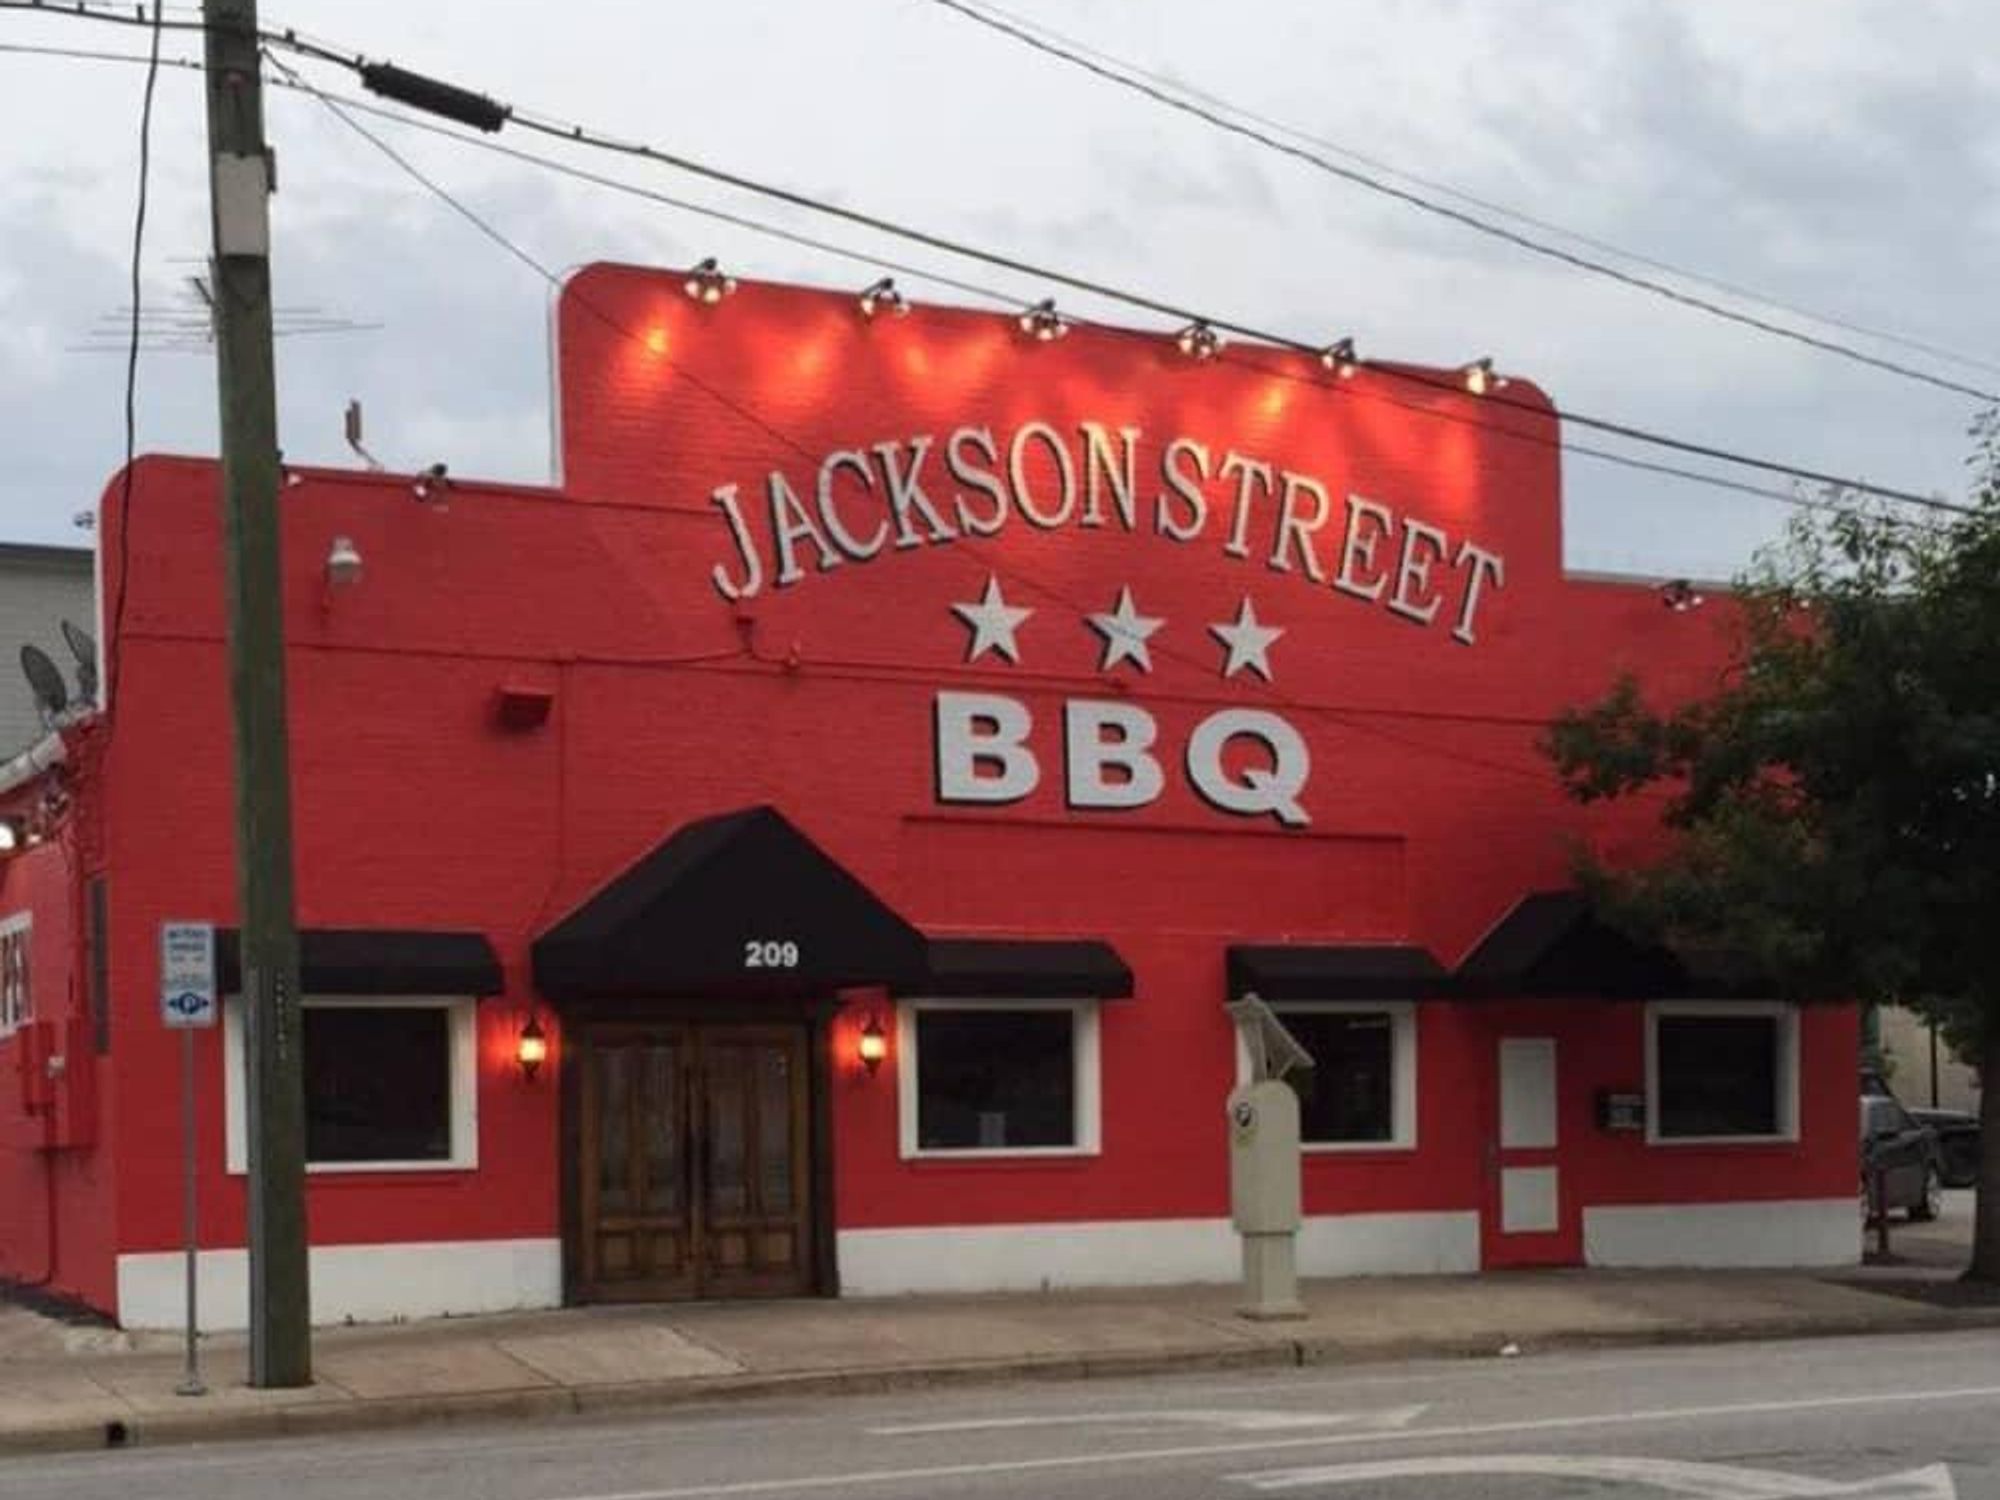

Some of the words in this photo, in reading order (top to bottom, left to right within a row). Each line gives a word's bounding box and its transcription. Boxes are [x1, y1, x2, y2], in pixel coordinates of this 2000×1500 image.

[711, 421, 1141, 599] JACKSON
[1156, 438, 1505, 645] STREET
[934, 689, 1312, 828] BBQ
[745, 941, 799, 967] 209
